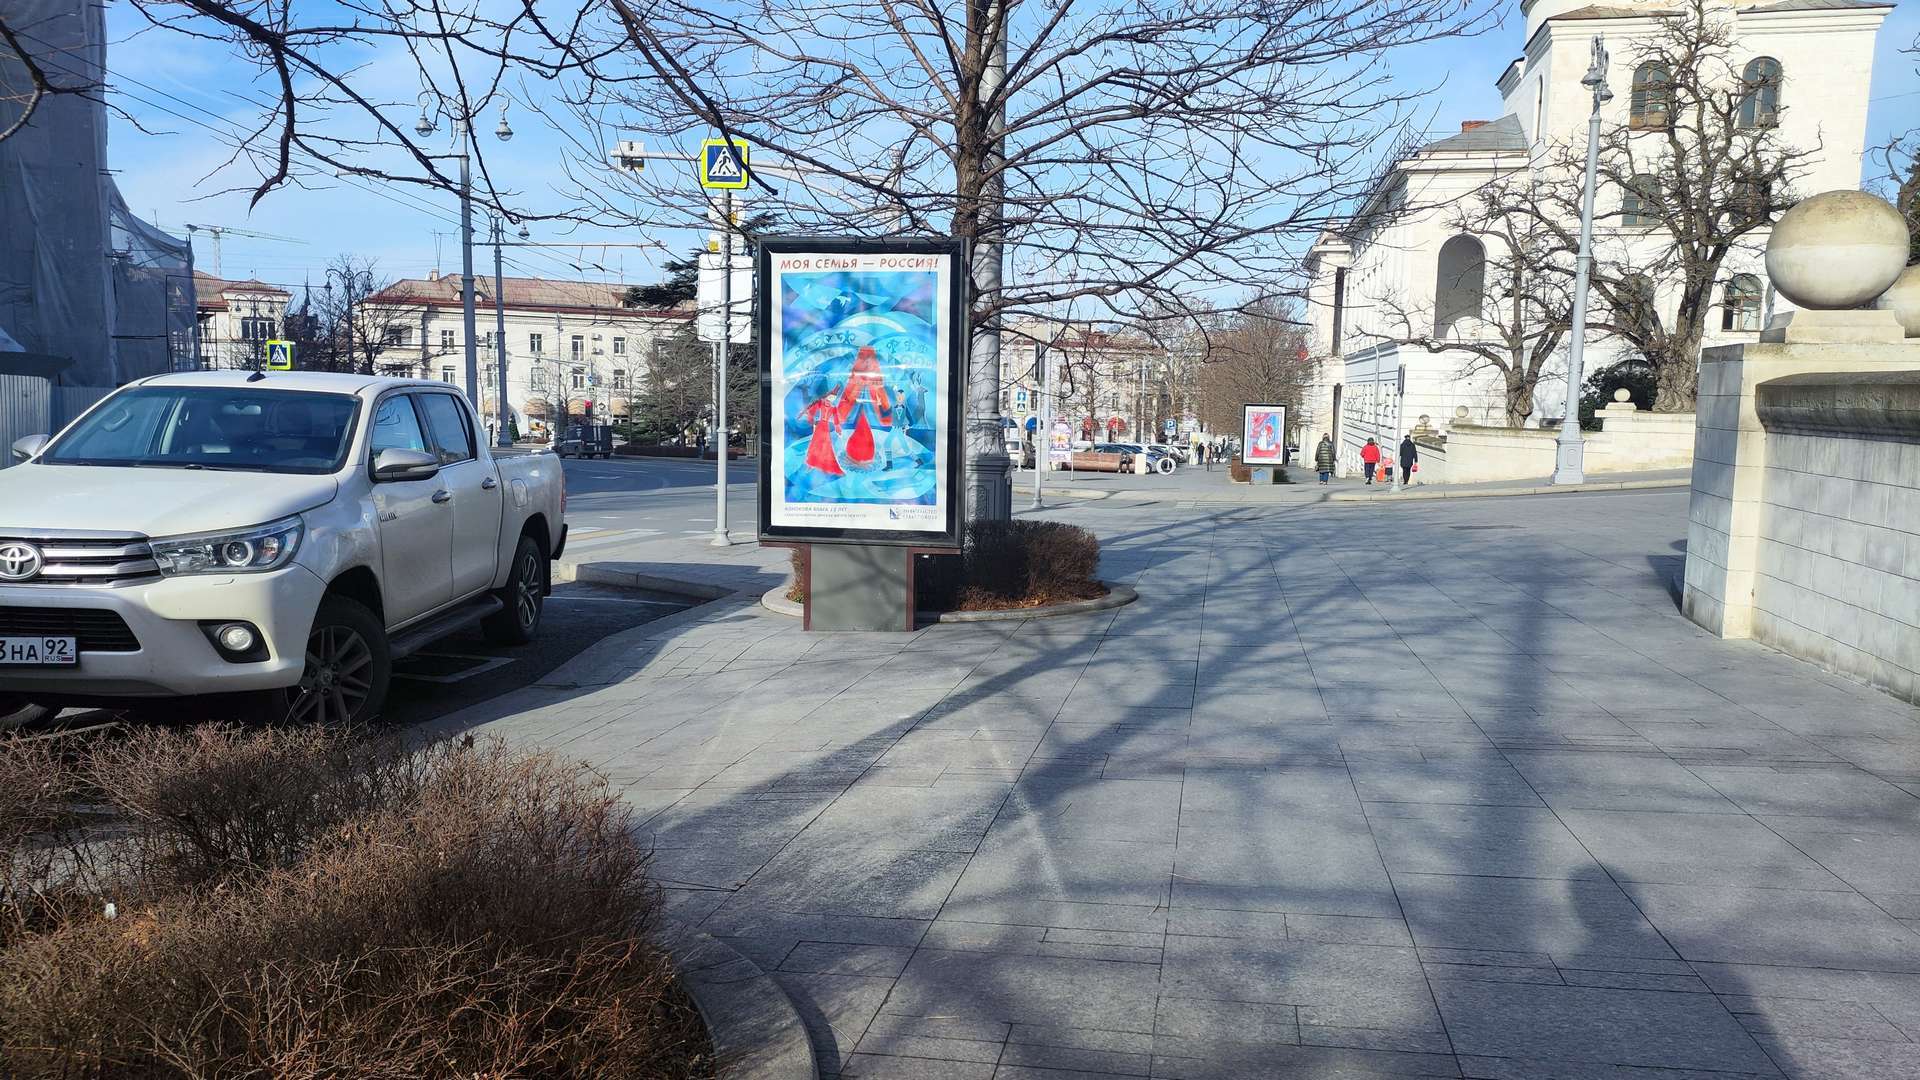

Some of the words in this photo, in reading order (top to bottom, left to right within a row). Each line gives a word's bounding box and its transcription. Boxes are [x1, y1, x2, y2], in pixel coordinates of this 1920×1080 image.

[781, 258, 810, 269] МОЯ
[815, 258, 858, 269] СЕМЬЯ
[879, 257, 939, 269] РОССИЯ!
[45, 639, 68, 655] 92
